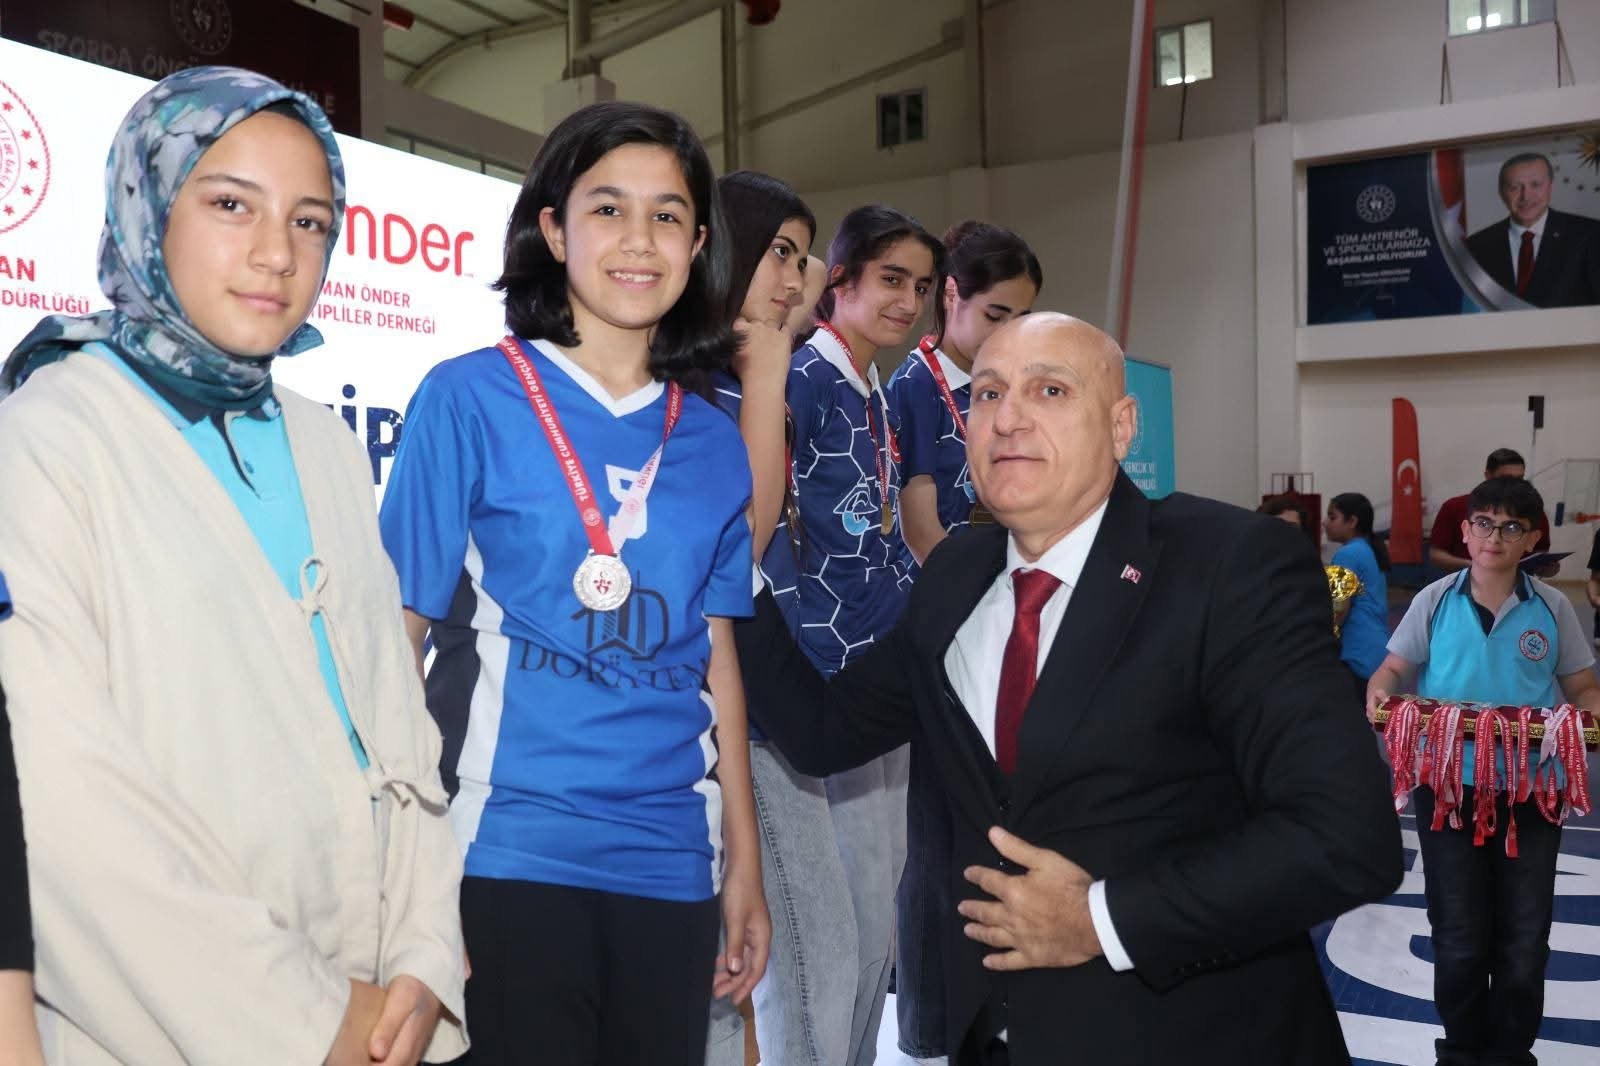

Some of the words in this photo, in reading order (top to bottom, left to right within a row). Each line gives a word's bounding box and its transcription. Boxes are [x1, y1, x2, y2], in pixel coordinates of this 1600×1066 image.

[361, 282, 411, 309] ÖNDER
[377, 311, 436, 335] DERNEĞİ
[531, 394, 569, 457] CUMHURİYETİ
[564, 458, 589, 503] TÜRKİYE
